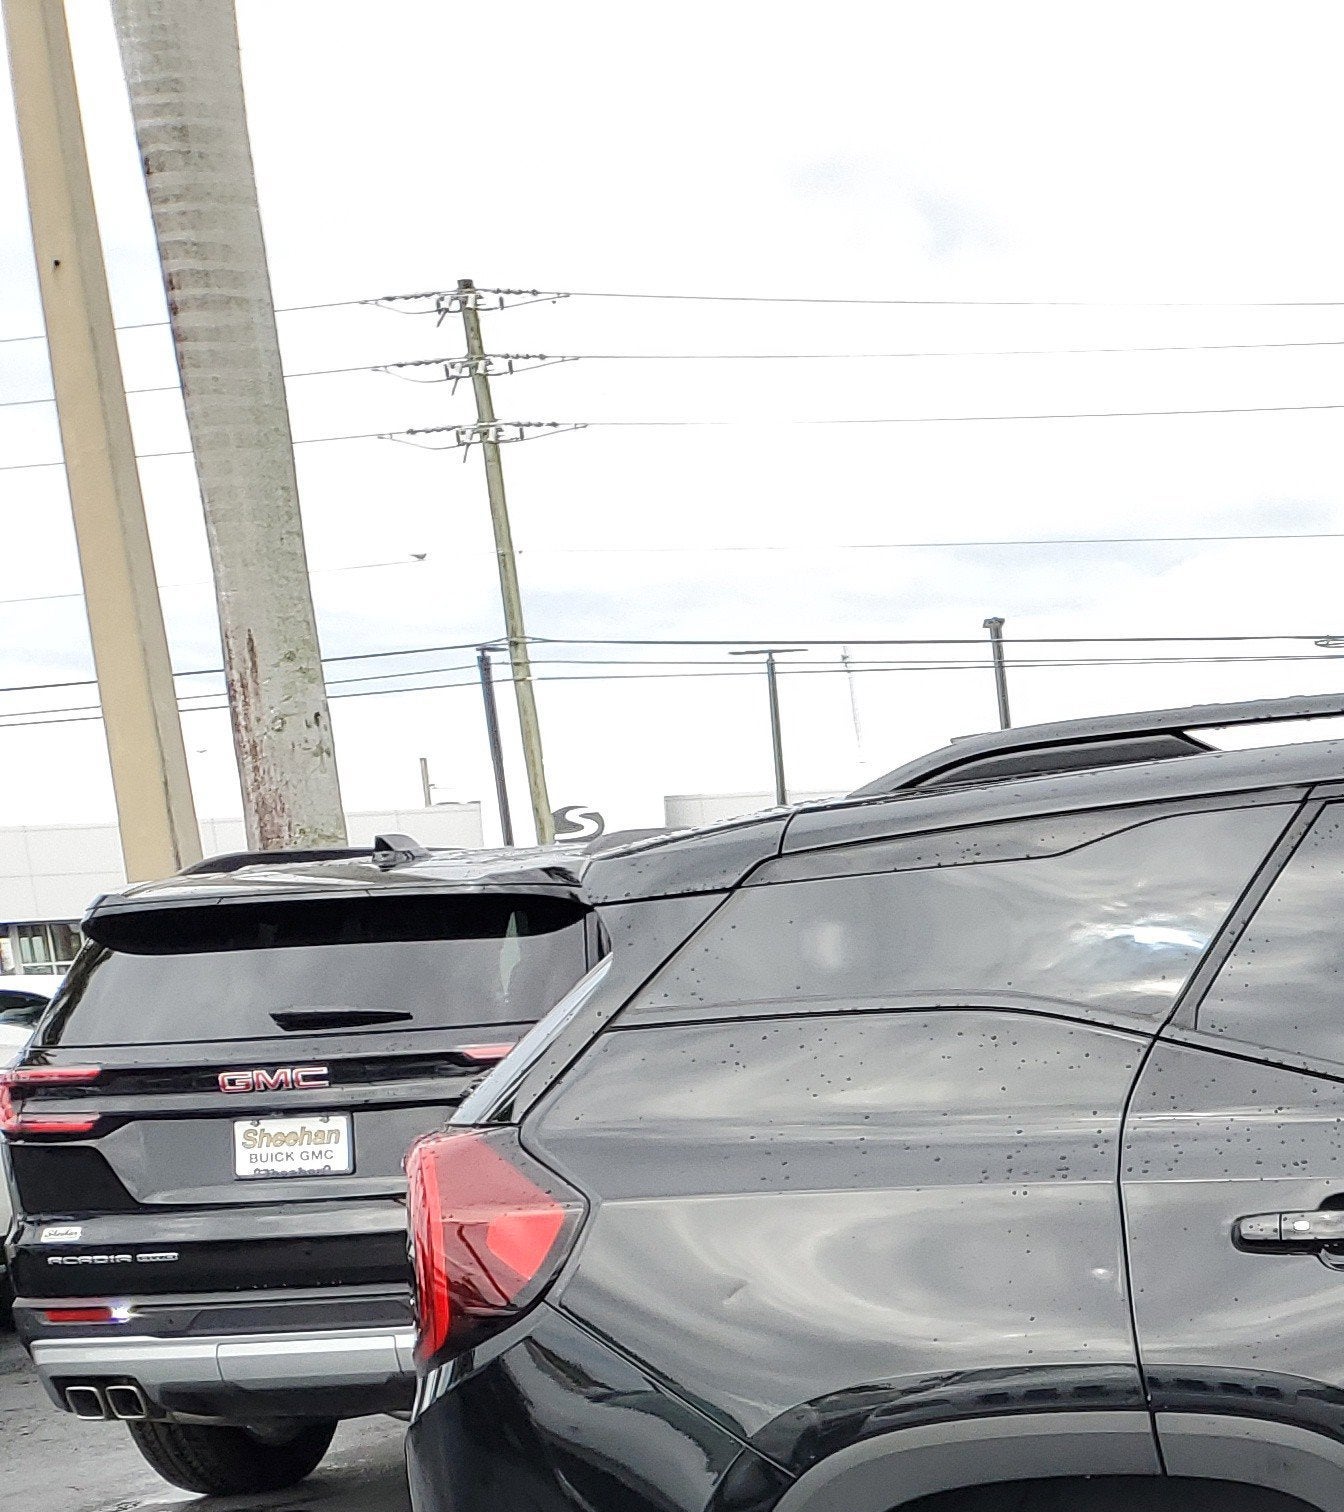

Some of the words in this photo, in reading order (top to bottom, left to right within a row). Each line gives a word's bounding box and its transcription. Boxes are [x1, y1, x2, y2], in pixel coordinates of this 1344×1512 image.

[218, 1066, 330, 1093] GMC
[242, 1126, 341, 1149] Sheehan
[249, 1151, 295, 1163] BUICK
[300, 1149, 334, 1161] GMC
